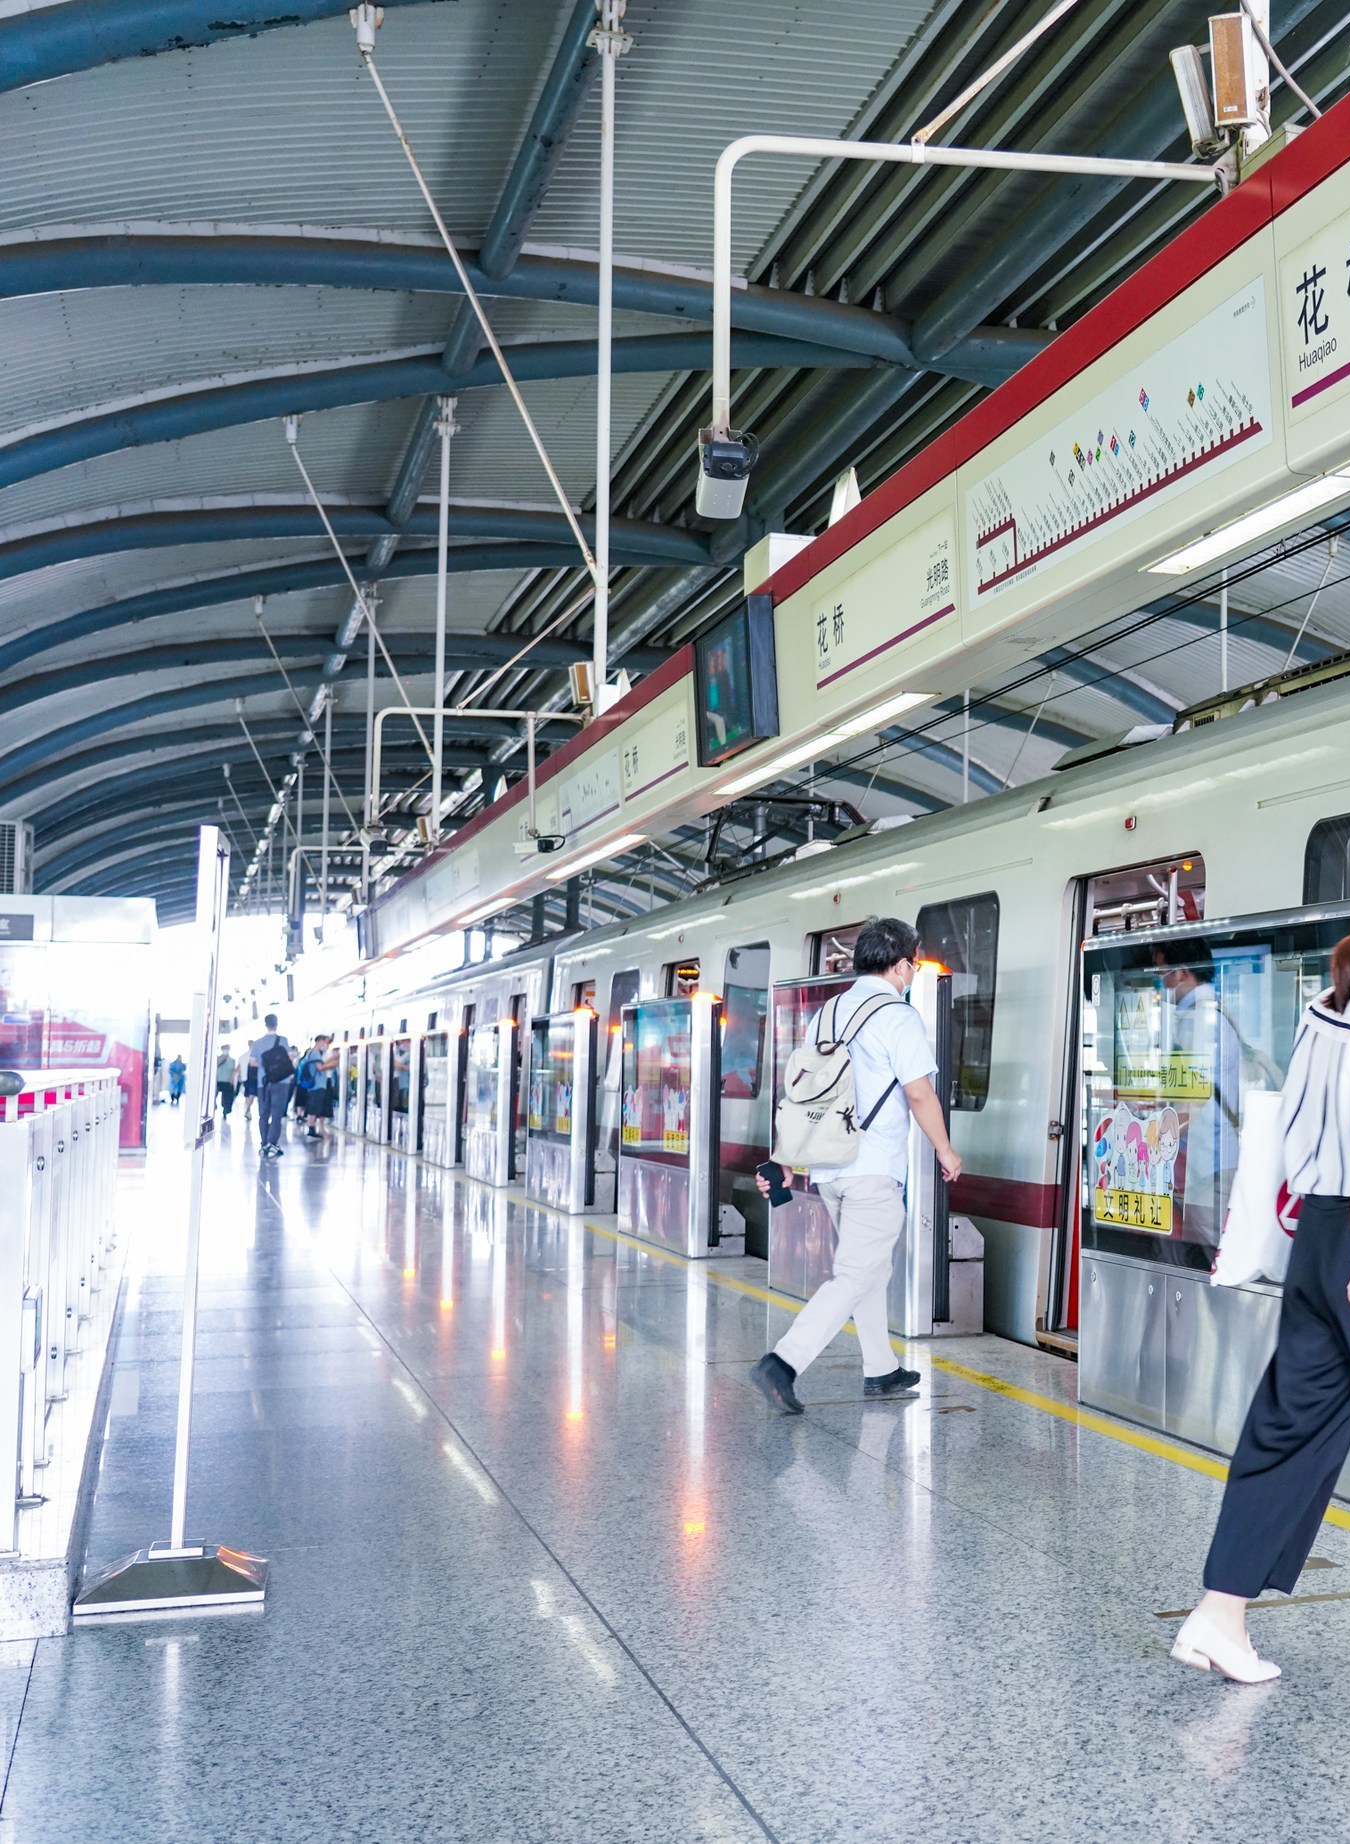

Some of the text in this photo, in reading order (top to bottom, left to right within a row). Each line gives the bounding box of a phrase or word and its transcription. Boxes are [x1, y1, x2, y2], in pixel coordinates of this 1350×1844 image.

[1299, 336, 1337, 373] Huaqiao
[927, 558, 949, 592] 光明路
[817, 603, 844, 657] 花桥
[1104, 1192, 1162, 1226] 文明礼让
